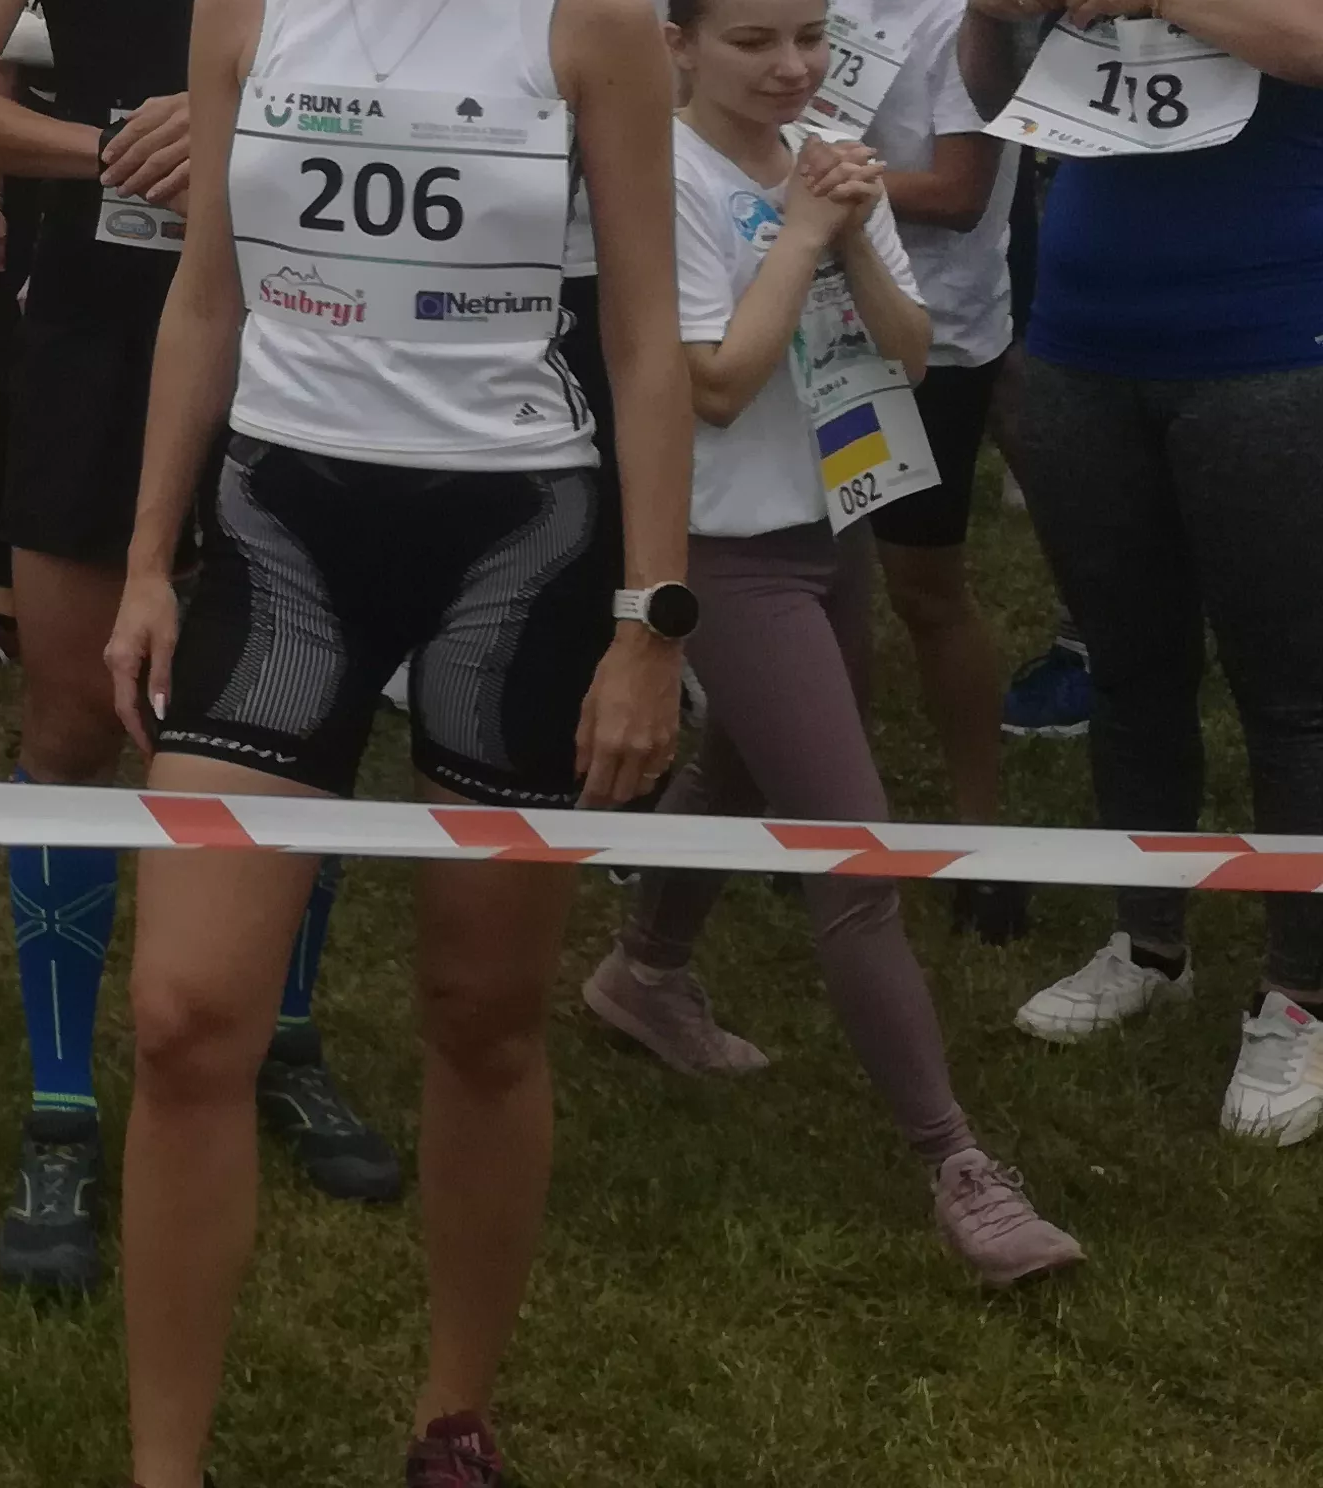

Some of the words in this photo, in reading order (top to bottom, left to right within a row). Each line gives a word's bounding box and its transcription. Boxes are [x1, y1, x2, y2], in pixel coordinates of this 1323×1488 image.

[299, 93, 342, 114] RUN
[347, 99, 361, 115] 4
[365, 99, 385, 117] A
[297, 114, 363, 136] SMILE
[298, 157, 464, 241] 206
[446, 291, 553, 315] Netrium
[838, 471, 883, 516] 082
